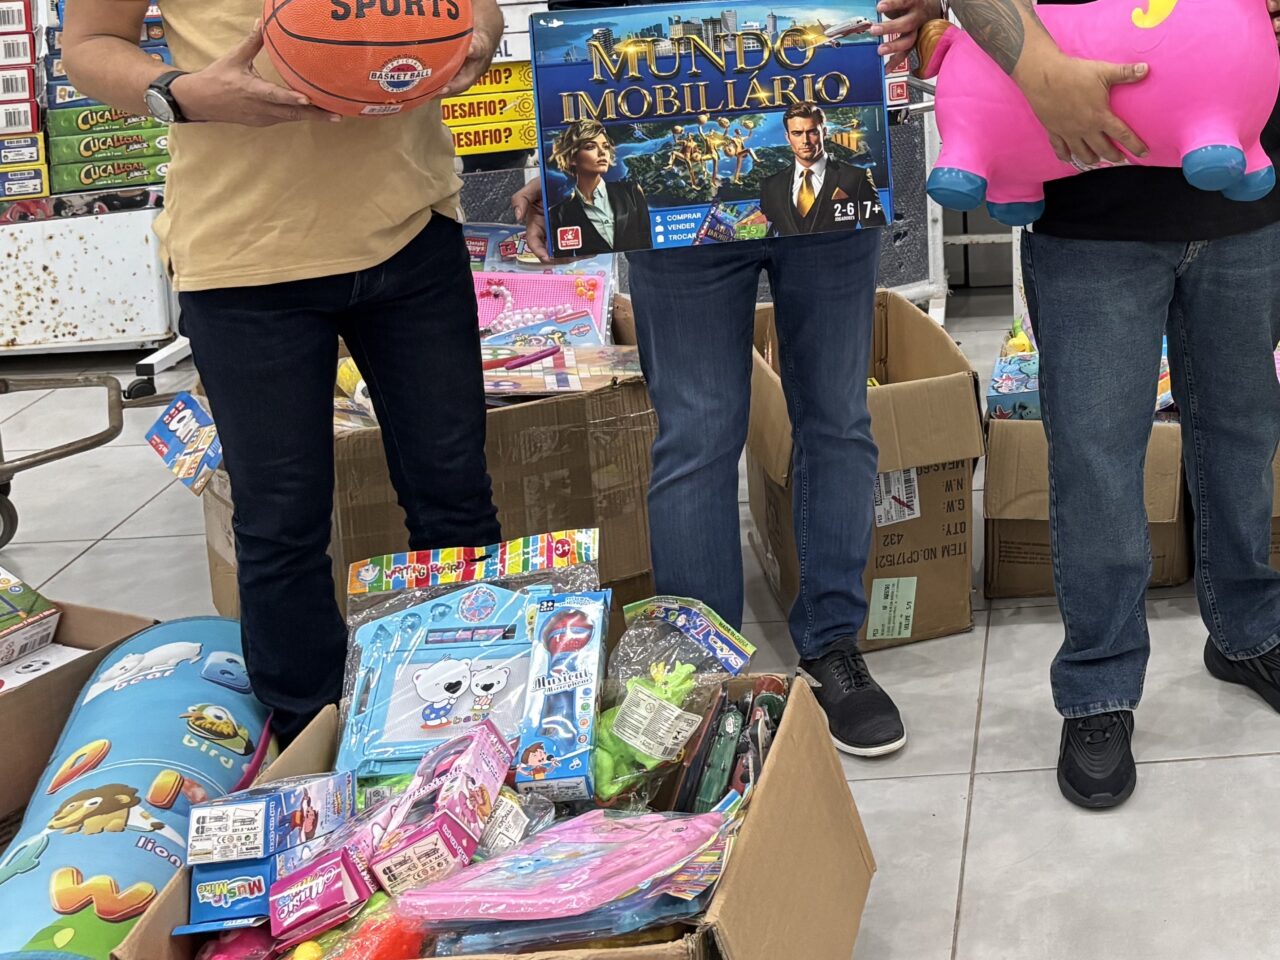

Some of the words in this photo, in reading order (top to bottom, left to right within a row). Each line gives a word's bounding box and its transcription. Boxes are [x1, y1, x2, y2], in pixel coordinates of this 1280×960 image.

[588, 27, 815, 81] MUNDO
[370, 72, 407, 81] BASKET
[409, 69, 430, 80] BALL
[476, 67, 513, 86] AFIO?
[559, 70, 850, 124] IMOBILIÁRIO
[442, 98, 507, 121] DESAFIO?
[667, 212, 702, 222] COMPRAR
[834, 202, 855, 217] 2-6
[863, 200, 881, 219] 7+
[668, 222, 695, 231] VENDER
[668, 232, 697, 241] TROCAR
[942, 521, 966, 536] QTY:
[555, 542, 571, 554] 3+
[883, 534, 904, 547] 432
[941, 542, 967, 557] ITEM
[384, 564, 426, 580] WRITING
[430, 560, 465, 578] BOARD
[718, 621, 731, 635] MADE
[691, 615, 744, 670] Toys
[114, 669, 175, 690] bear
[533, 670, 592, 691] Musical
[452, 712, 489, 725] baby
[182, 734, 234, 769] bird
[135, 836, 183, 868] lion
[198, 882, 229, 897] Mike
[211, 876, 265, 907] Music
